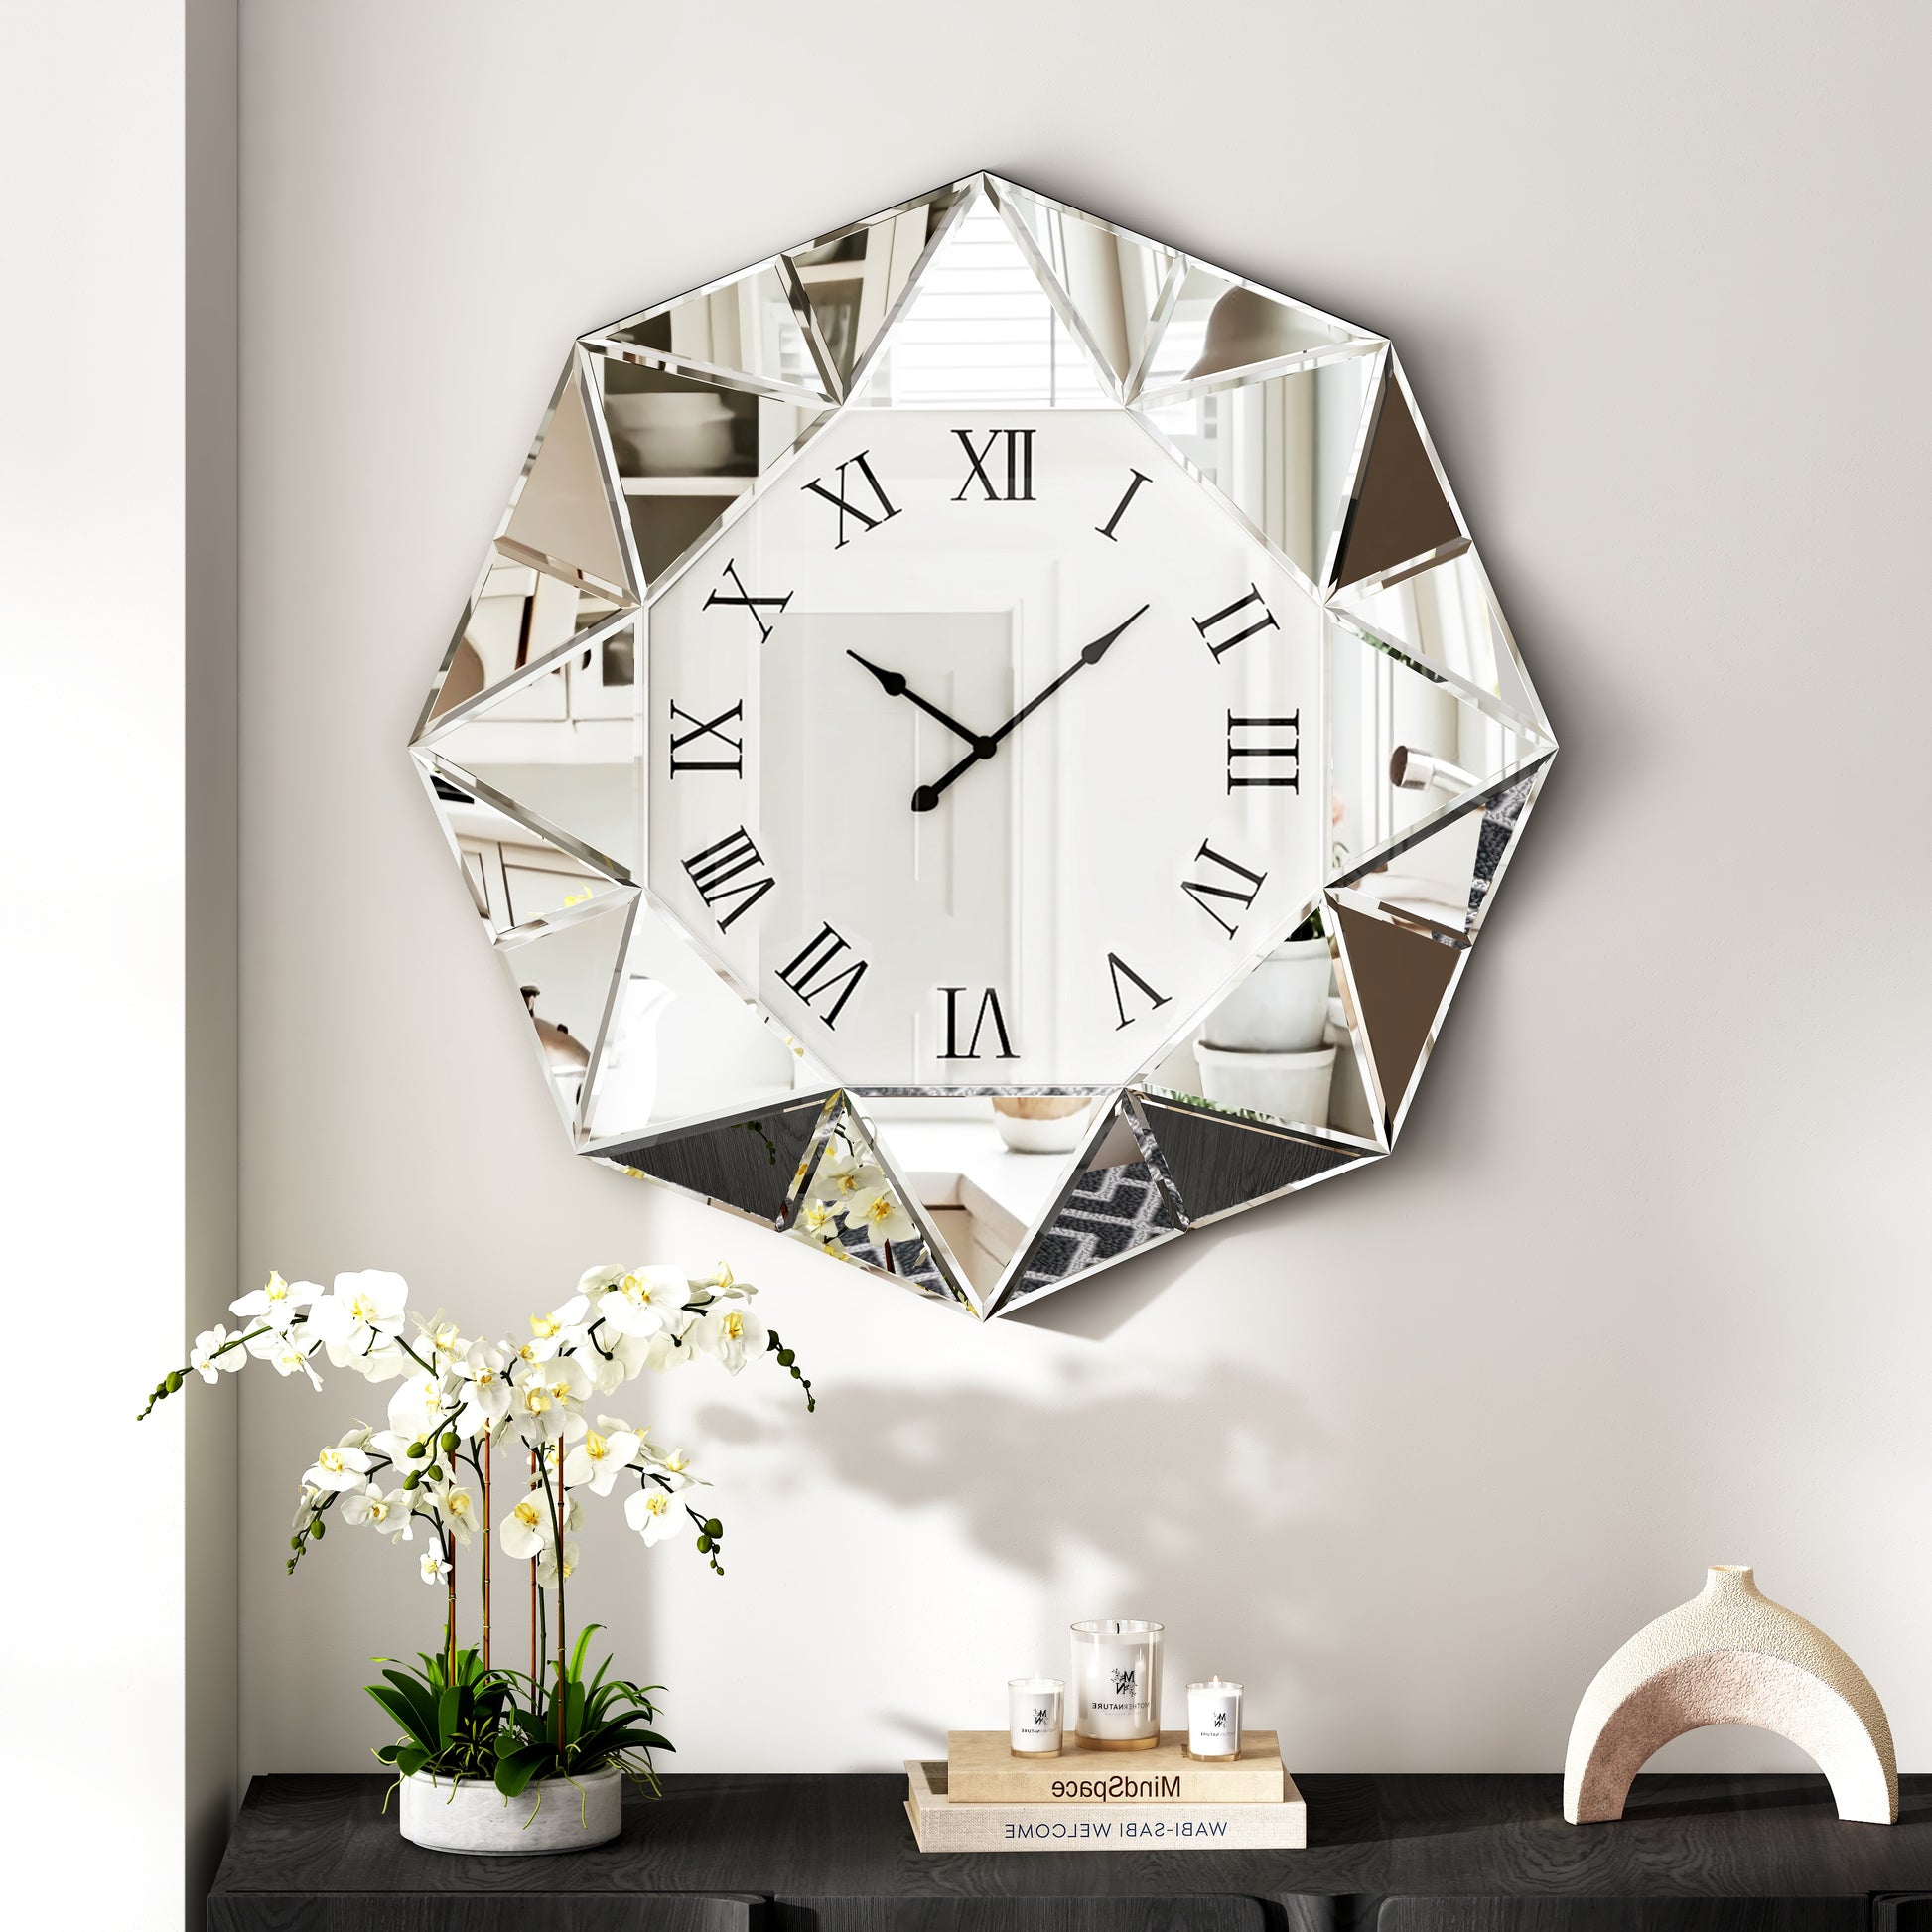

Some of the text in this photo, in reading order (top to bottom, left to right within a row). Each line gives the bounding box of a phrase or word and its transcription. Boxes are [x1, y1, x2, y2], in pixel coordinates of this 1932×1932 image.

[800, 450, 902, 549] XI
[951, 429, 1036, 501] XII
[1095, 468, 1153, 542] I
[702, 558, 794, 644] X
[1192, 582, 1280, 664] II
[670, 699, 743, 780] IX
[1227, 708, 1299, 795] III
[681, 825, 776, 934] VIII
[1180, 838, 1268, 940] IV
[774, 921, 869, 1031] VII
[1107, 952, 1173, 1031] V
[936, 987, 1021, 1059] VI
